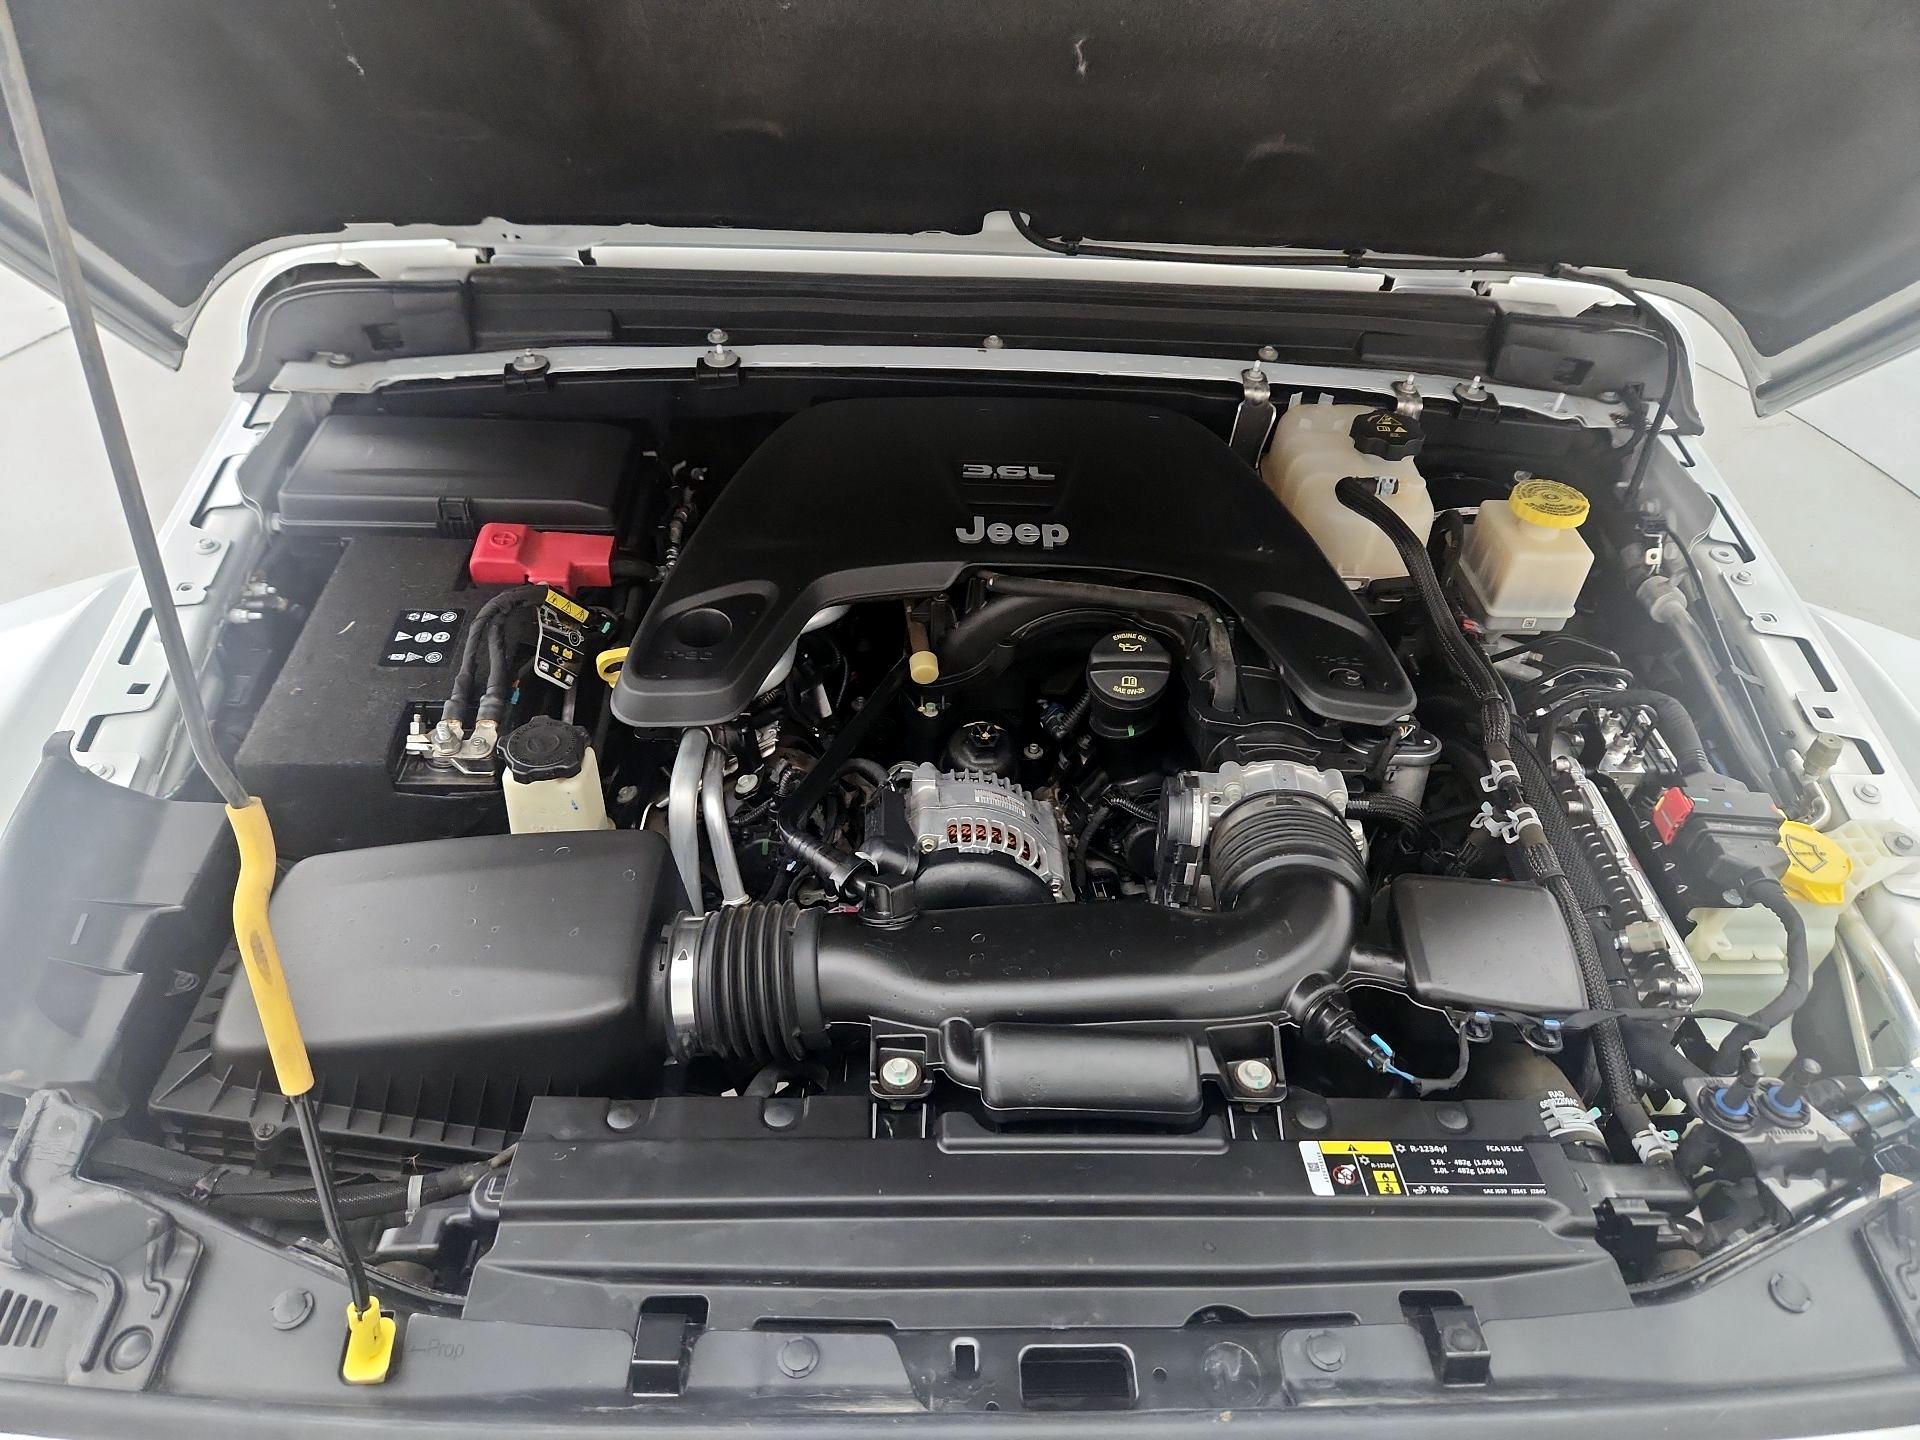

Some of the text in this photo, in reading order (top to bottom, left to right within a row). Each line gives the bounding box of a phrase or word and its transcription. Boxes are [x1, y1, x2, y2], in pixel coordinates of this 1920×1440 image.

[963, 464, 1055, 480] 3.6L
[956, 516, 1069, 549] Jeep
[1112, 633, 1147, 642] ENGINE OIL
[1113, 685, 1125, 694] SAE
[1548, 1090, 1565, 1098] RAD
[1409, 1145, 1448, 1154] R-1234yf
[1430, 1186, 1449, 1194] PAG
